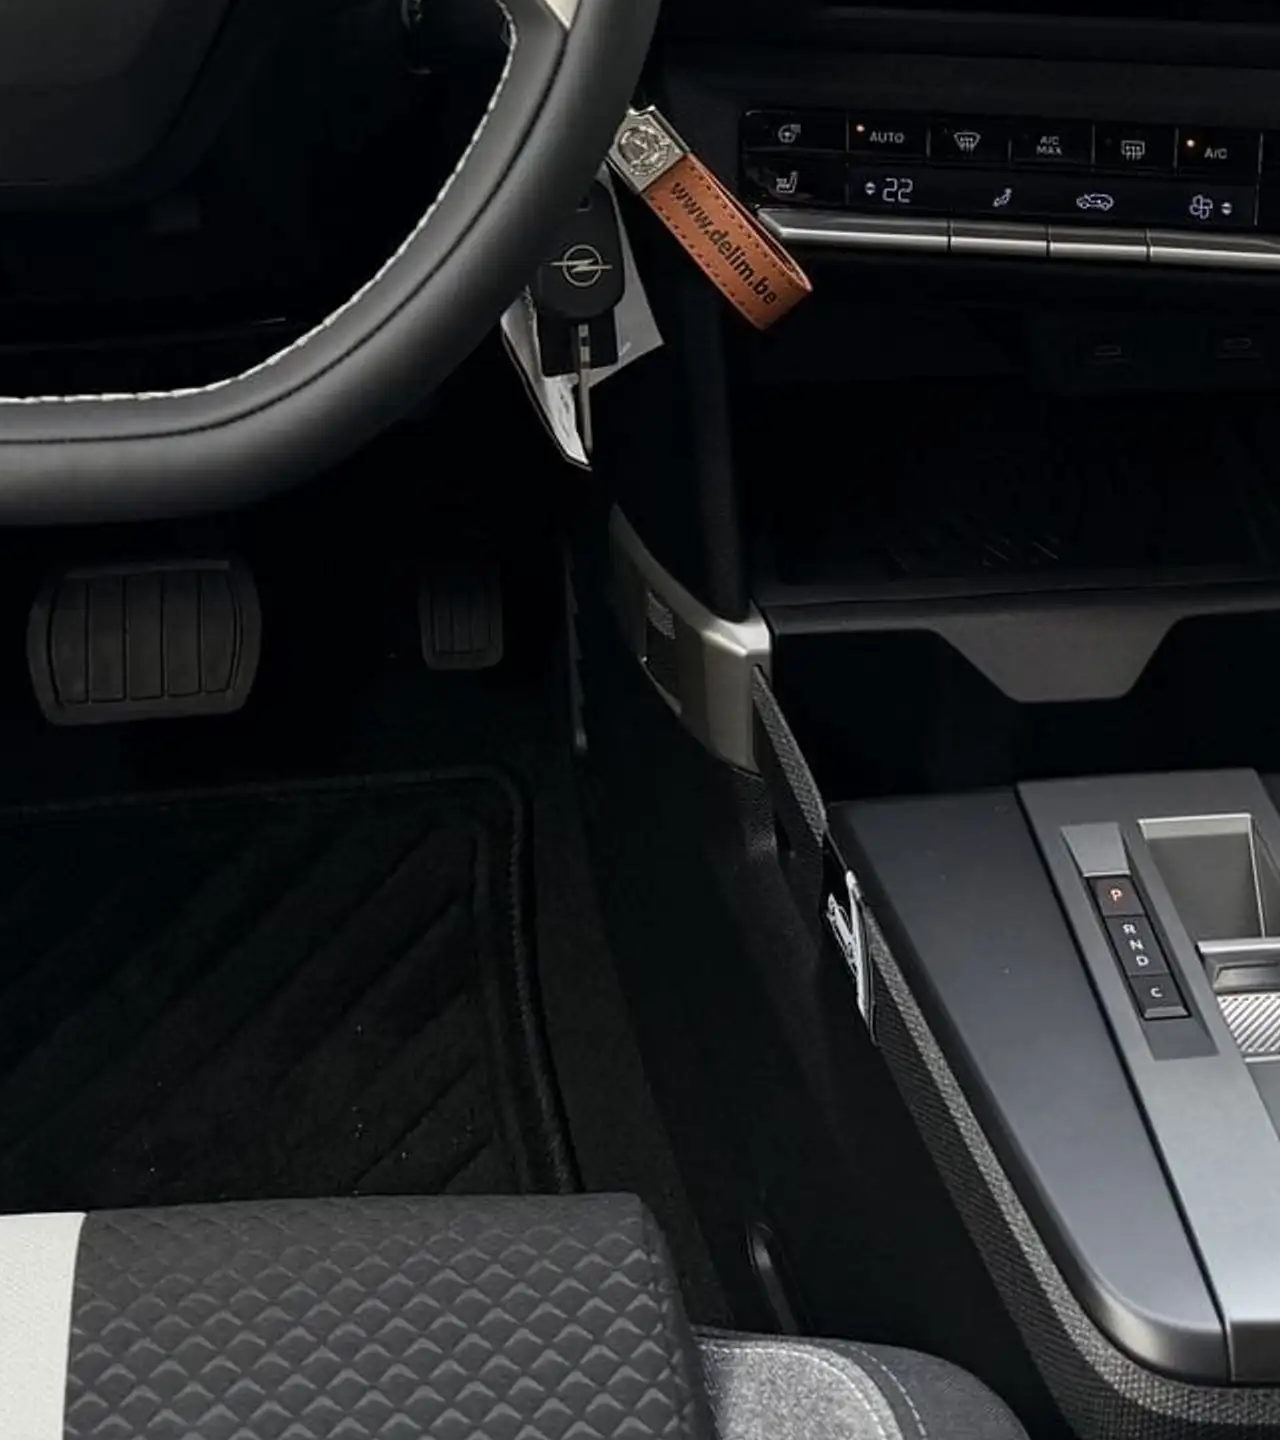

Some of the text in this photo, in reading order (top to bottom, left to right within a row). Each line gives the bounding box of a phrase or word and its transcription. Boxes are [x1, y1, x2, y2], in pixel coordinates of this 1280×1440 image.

[869, 131, 905, 143] AUTO
[1039, 135, 1060, 146] A/C
[1036, 145, 1063, 156] MAX
[1203, 147, 1228, 160] A/C
[882, 177, 914, 202] 22
[669, 181, 778, 306] www.delim.be
[1109, 887, 1123, 901] P
[1122, 923, 1137, 935] R
[1129, 939, 1145, 951] N
[1135, 955, 1150, 967] D
